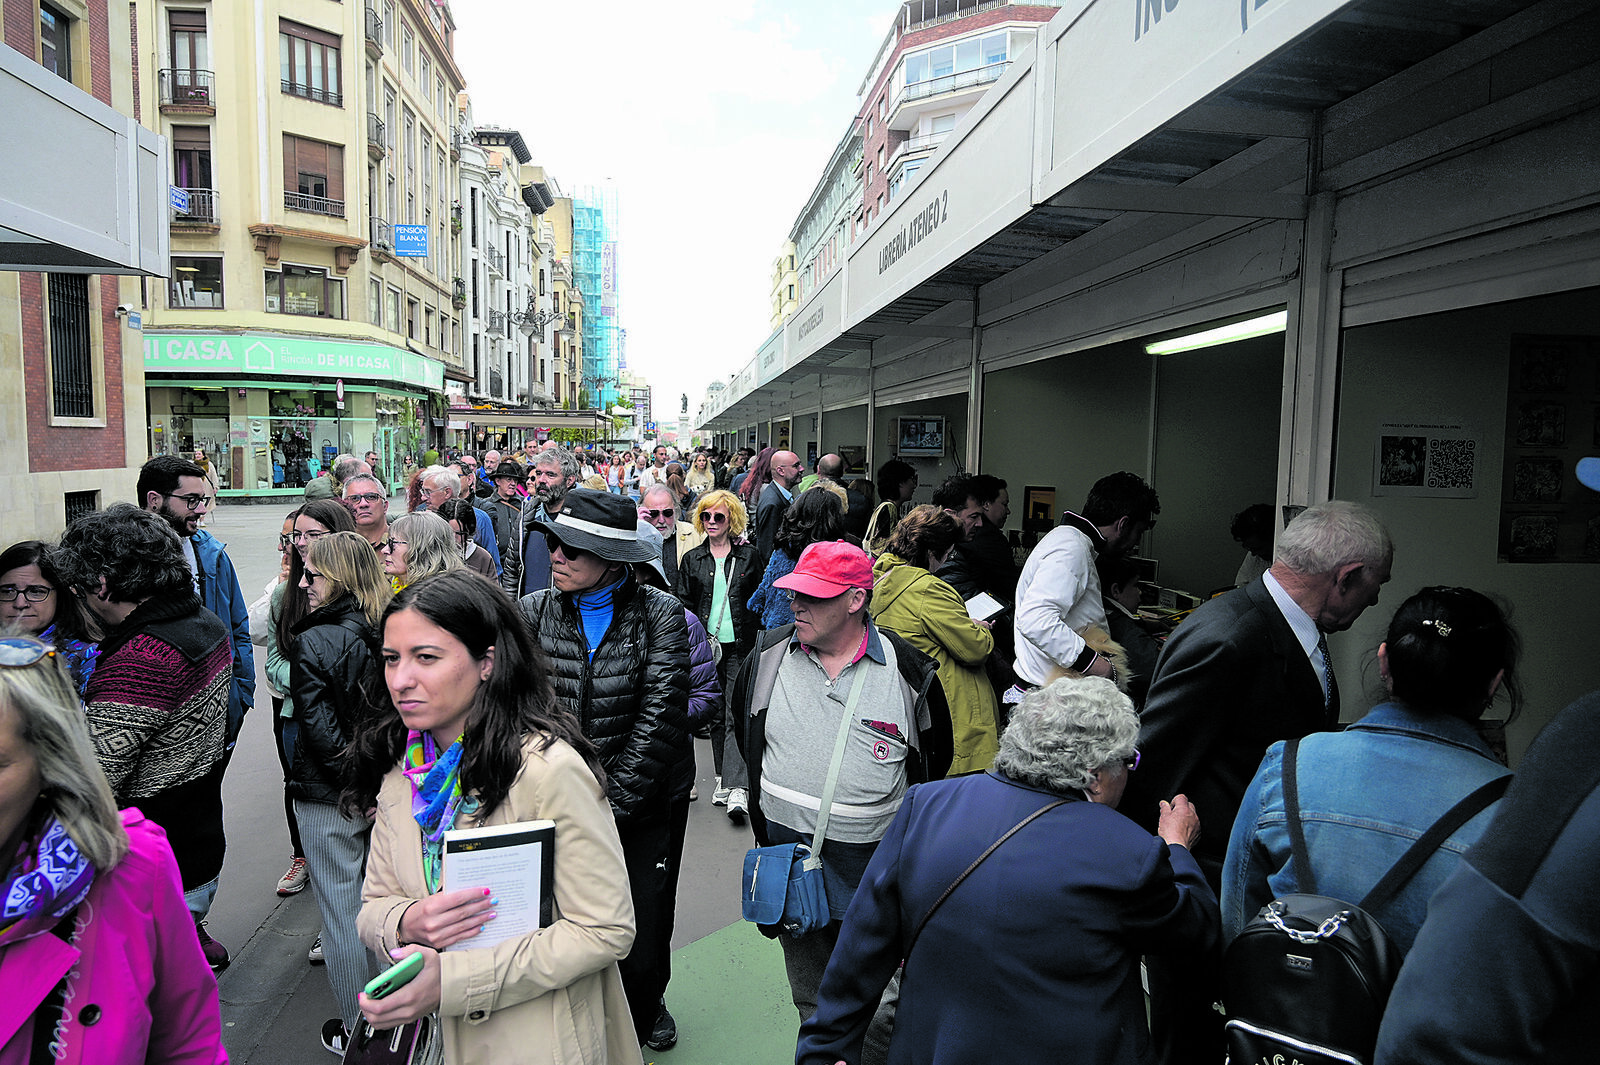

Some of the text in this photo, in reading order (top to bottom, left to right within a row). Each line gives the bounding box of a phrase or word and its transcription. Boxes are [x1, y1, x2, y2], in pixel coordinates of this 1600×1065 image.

[878, 189, 948, 275] LIBRERÍA ATENEO 2
[166, 339, 234, 360] CASA
[318, 353, 390, 370] DE MI CASA
